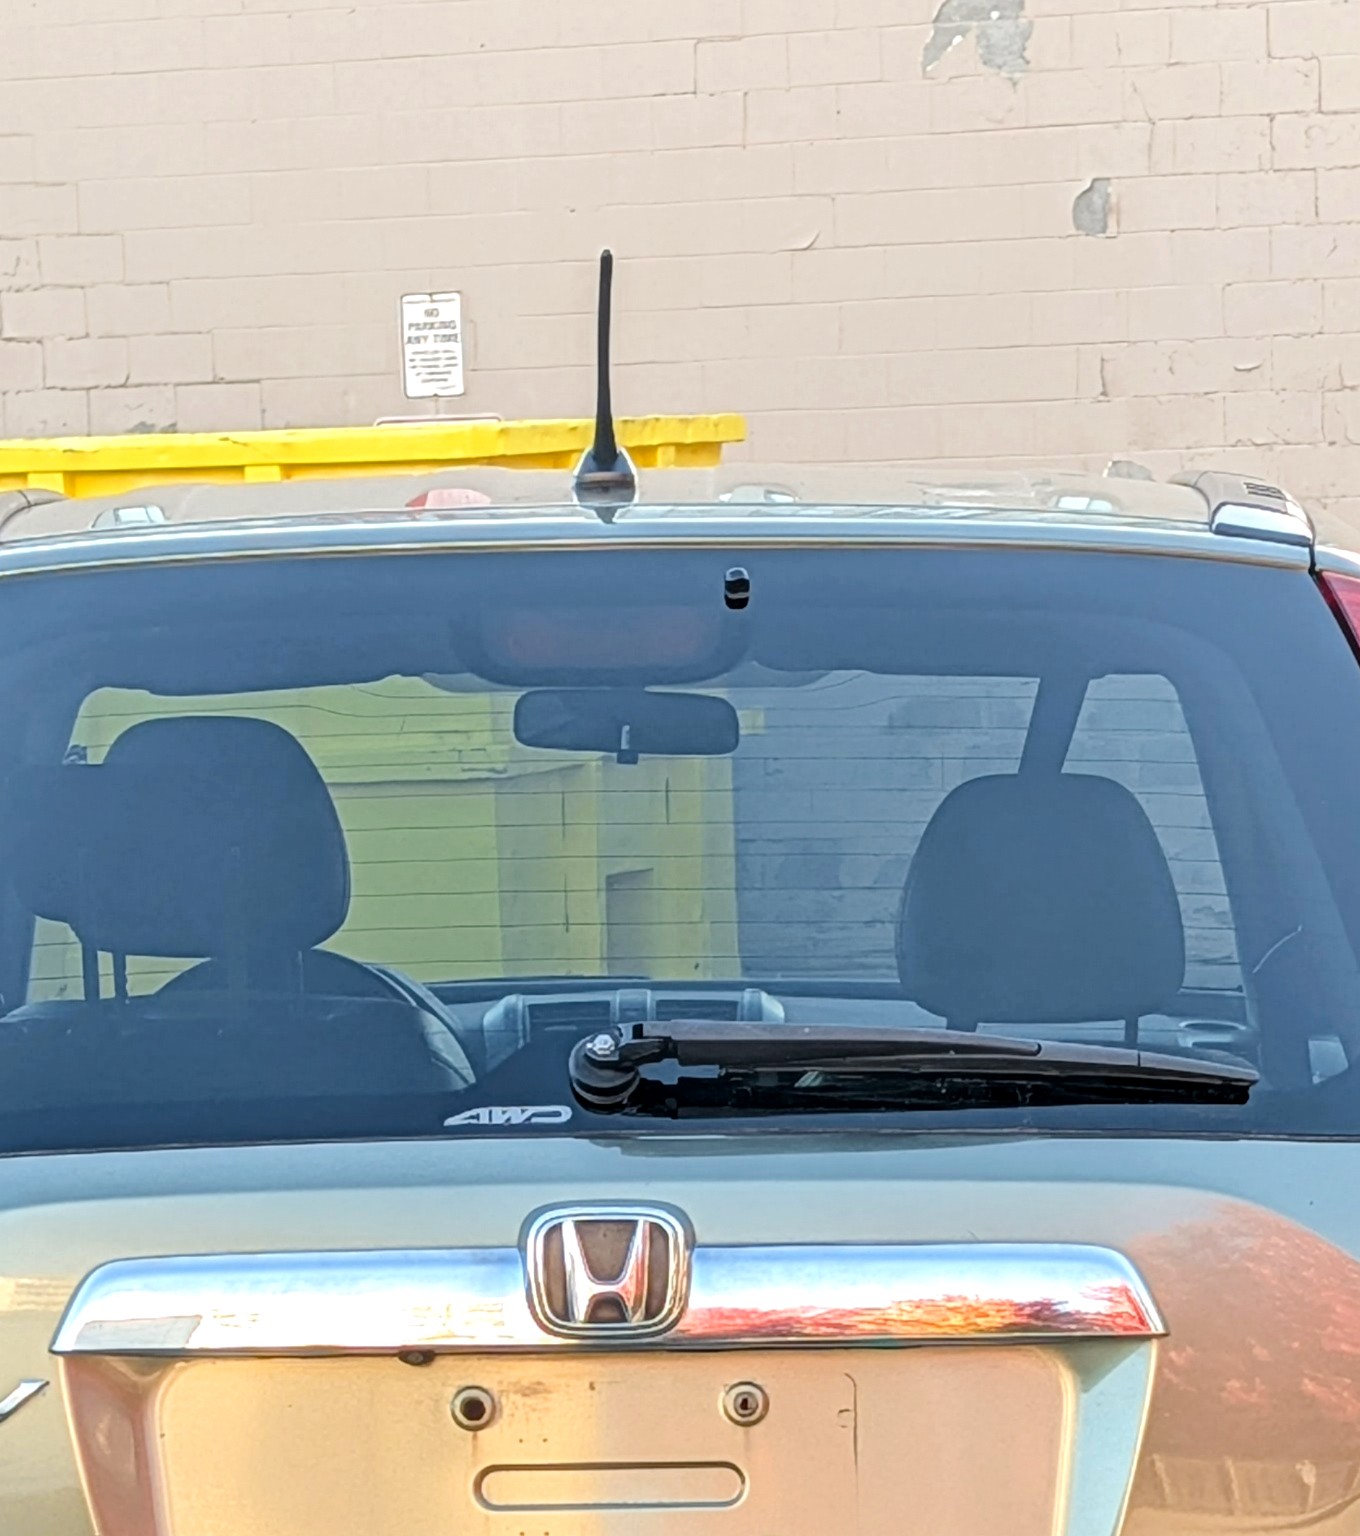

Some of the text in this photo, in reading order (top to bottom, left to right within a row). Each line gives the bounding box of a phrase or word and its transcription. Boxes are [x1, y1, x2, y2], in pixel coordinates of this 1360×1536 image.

[424, 308, 440, 318] NO
[408, 320, 457, 331] PARKING
[406, 333, 460, 345] ANY TIME
[443, 1105, 573, 1126] AWD
